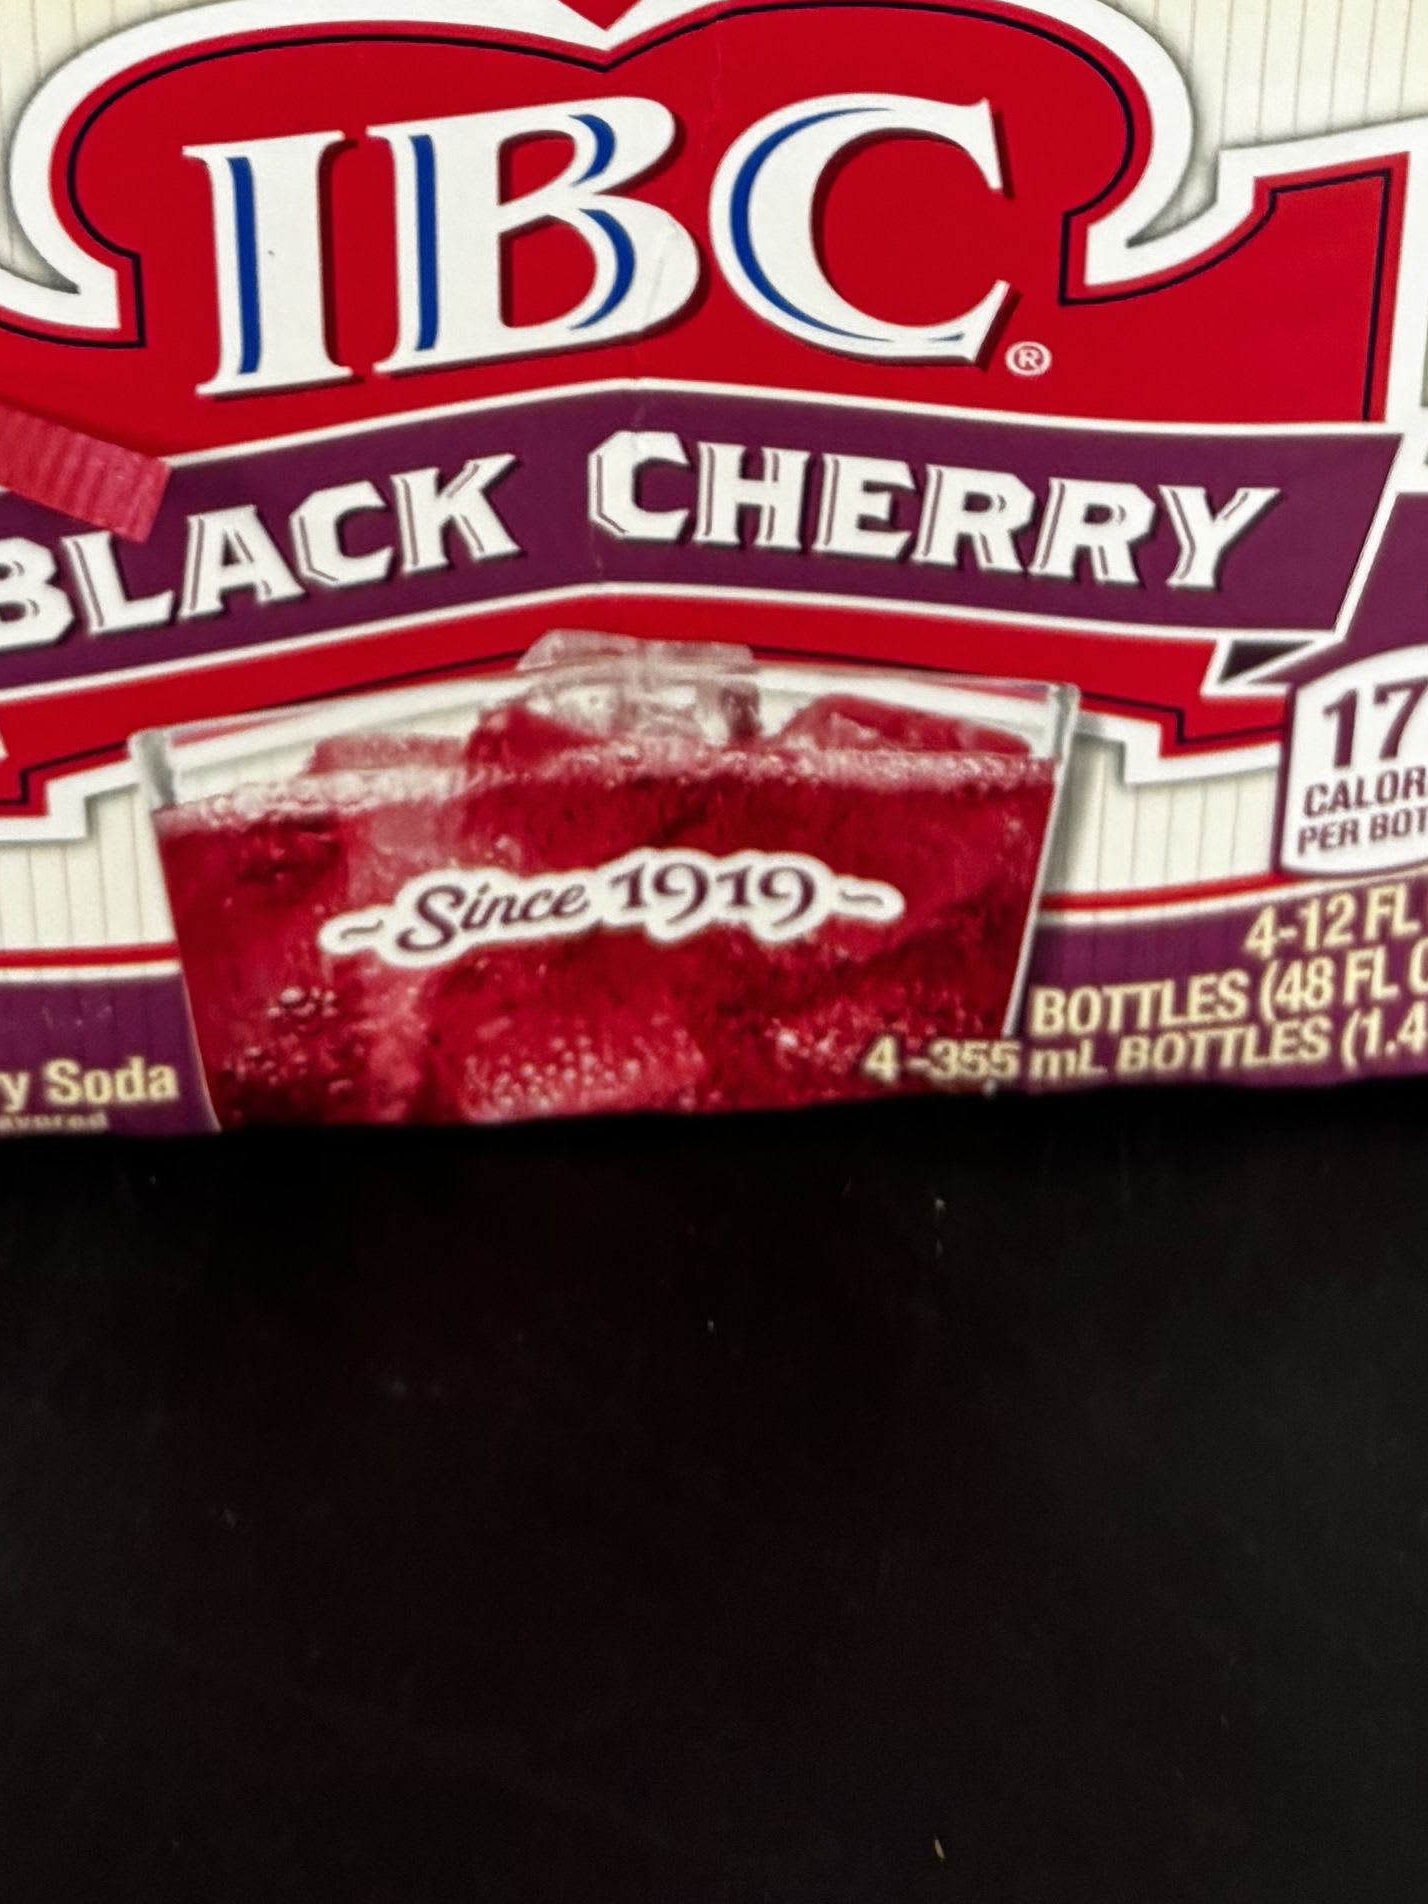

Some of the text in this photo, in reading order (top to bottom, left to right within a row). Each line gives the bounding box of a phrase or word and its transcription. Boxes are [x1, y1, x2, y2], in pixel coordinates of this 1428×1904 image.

[183, 93, 1012, 399] IBC
[586, 429, 1282, 591] CHERRY
[1297, 815, 1361, 857] PER
[394, 861, 817, 956] Since 1919
[1245, 890, 1360, 960] 4-12
[1363, 884, 1420, 940] FL
[1032, 971, 1251, 1037] BOTTLES
[1261, 958, 1336, 1020] (48
[1341, 945, 1399, 997] FL
[41, 1055, 181, 1105] Soda
[1028, 1035, 1109, 1081] mL
[1116, 1019, 1331, 1073] BOTTLES
